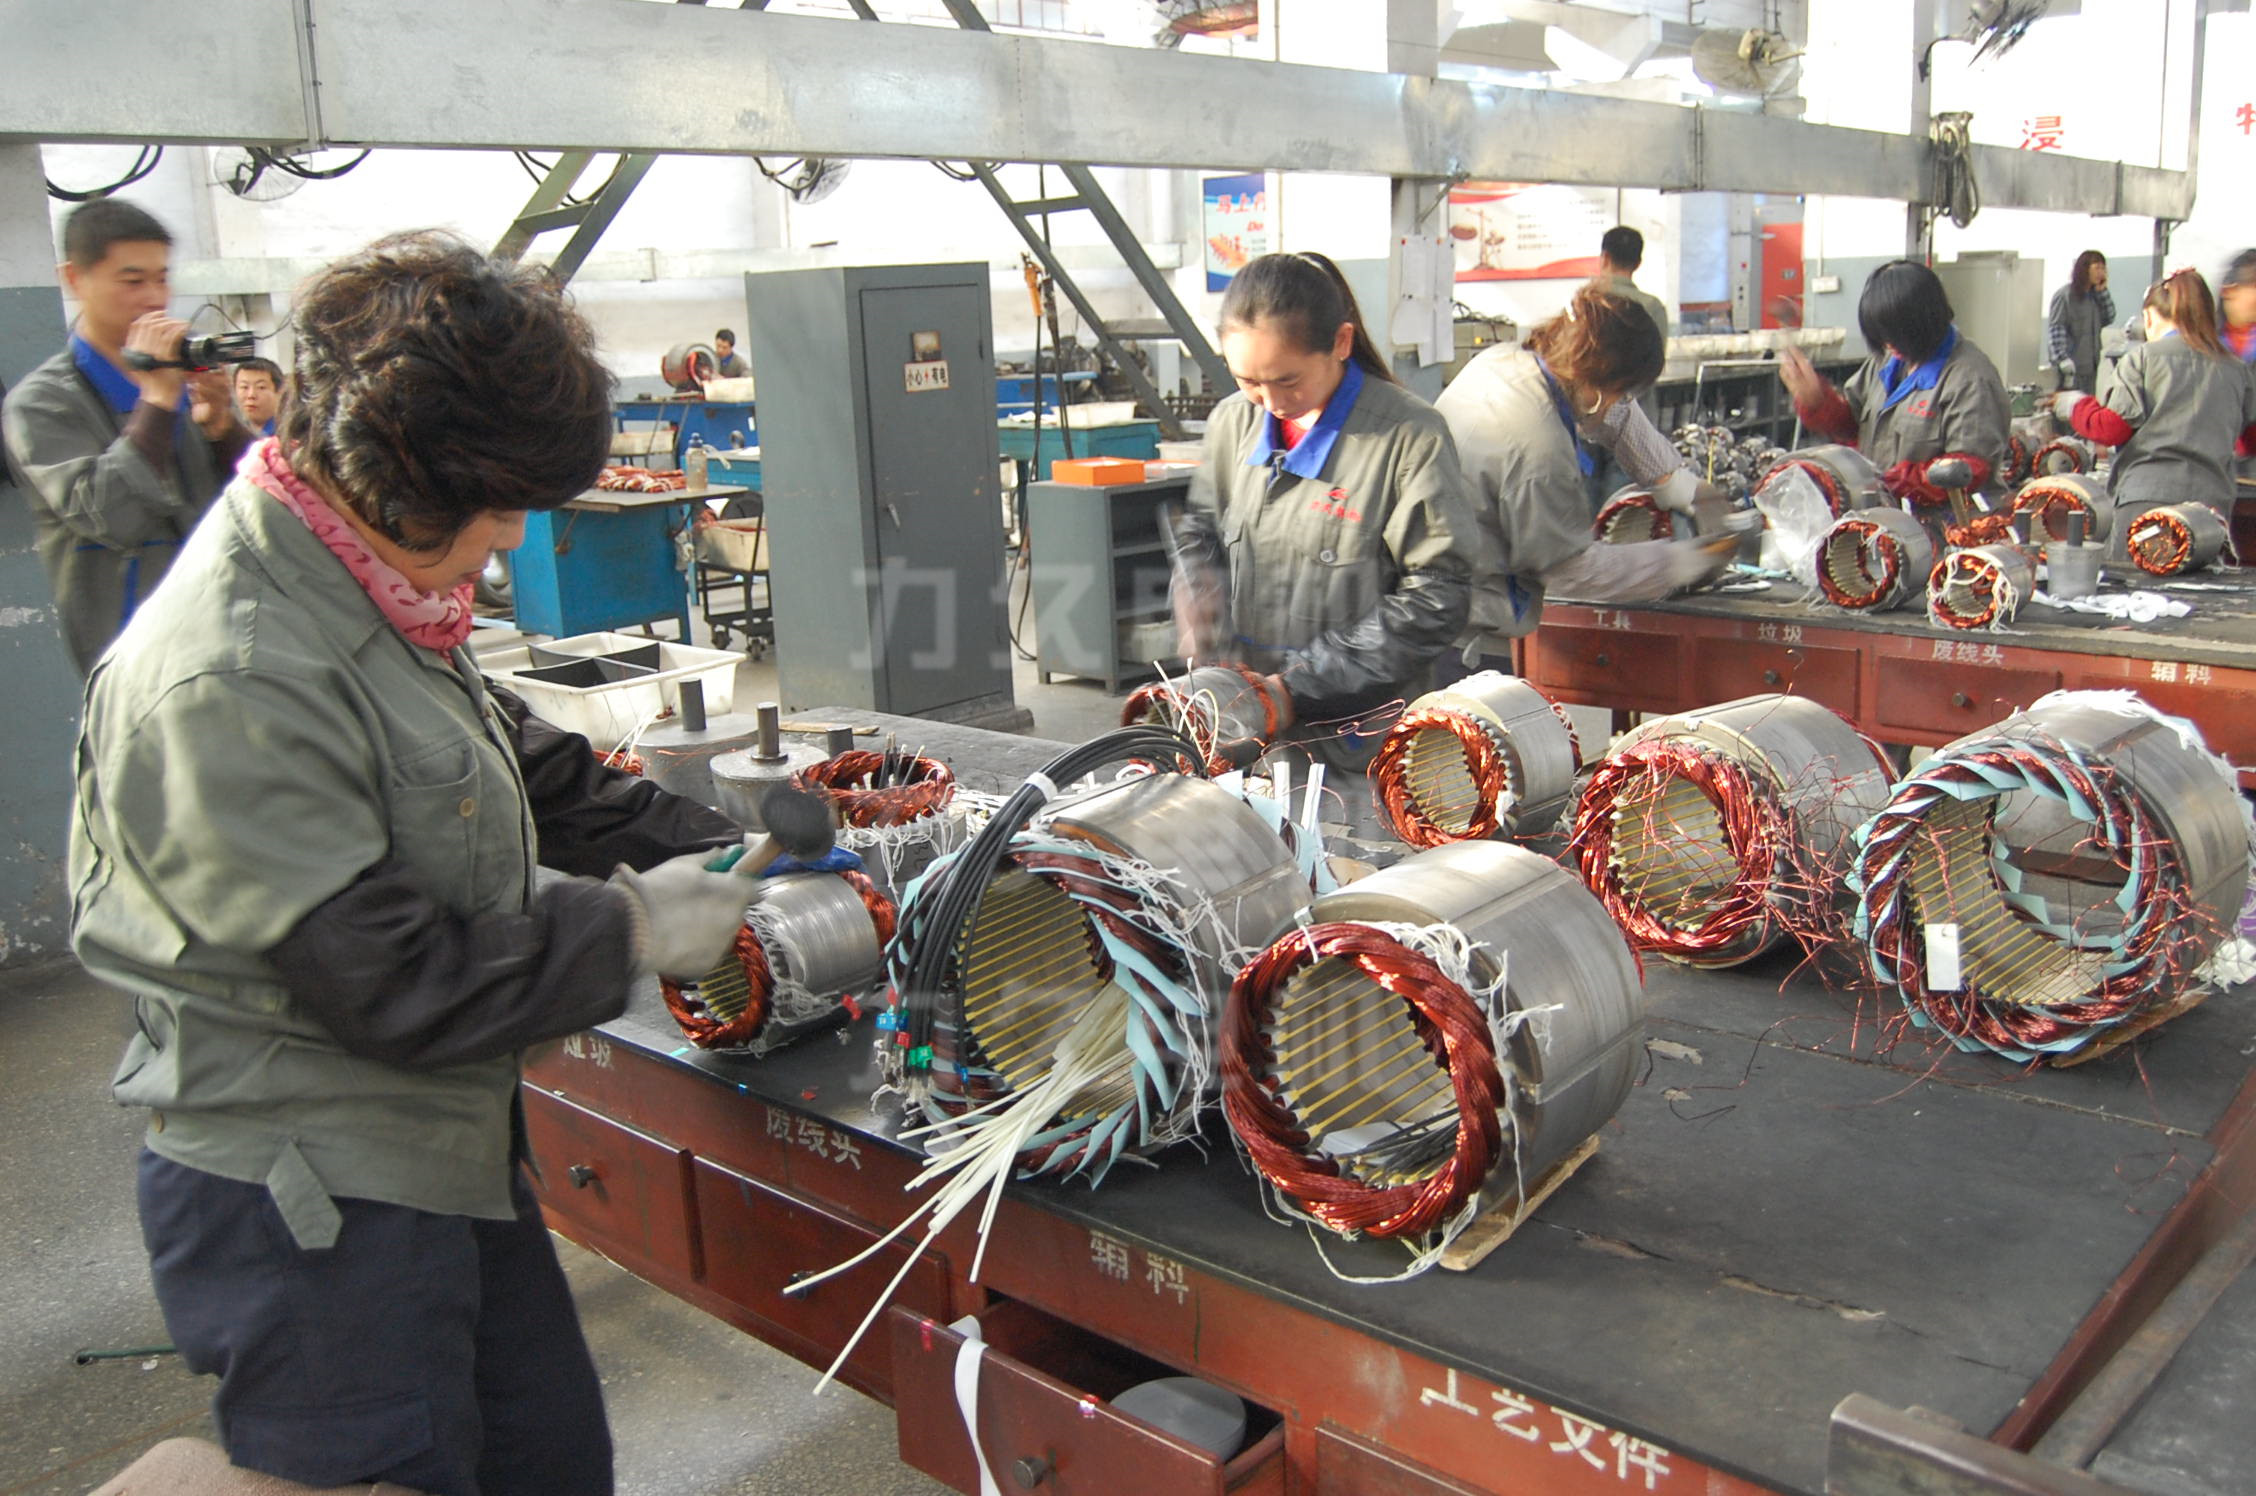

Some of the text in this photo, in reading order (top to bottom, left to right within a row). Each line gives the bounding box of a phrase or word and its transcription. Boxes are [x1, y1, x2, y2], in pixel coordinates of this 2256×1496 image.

[2019, 115, 2064, 151] 浸
[906, 366, 947, 386] 小心有电
[1593, 609, 1632, 631] 工具
[1758, 622, 1802, 643] 垃圾
[1932, 640, 2004, 664] 废线头
[2151, 661, 2211, 686] 辅料
[767, 1106, 861, 1170] 废线头
[1420, 1368, 1670, 1490] 工艺文件
